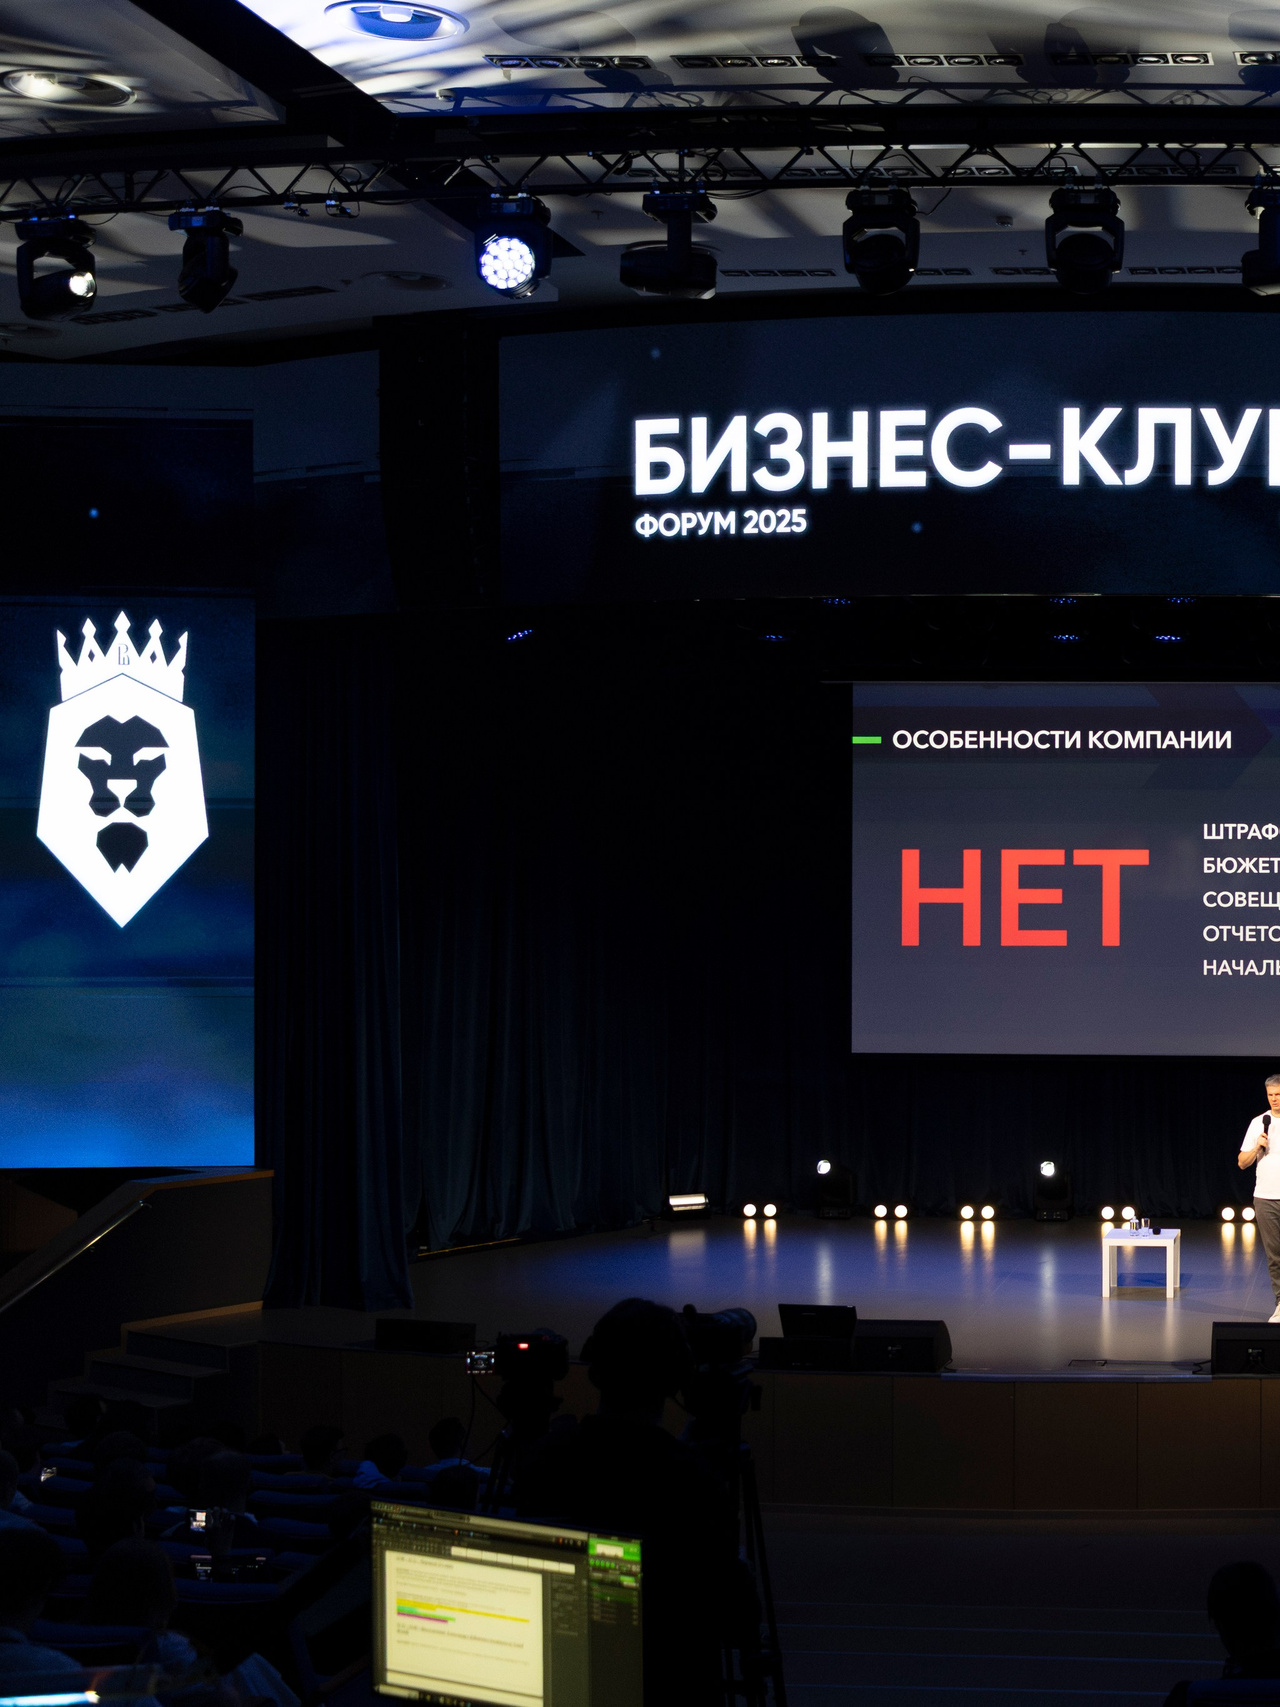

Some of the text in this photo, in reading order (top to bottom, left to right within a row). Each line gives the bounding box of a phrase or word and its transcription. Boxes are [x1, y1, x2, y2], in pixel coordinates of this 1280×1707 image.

[635, 508, 808, 538] ФОРУМ 2025
[892, 729, 1232, 750] ОСОБЕННОСТИ КОМПАНИИ
[901, 848, 1150, 947] НЕТ
